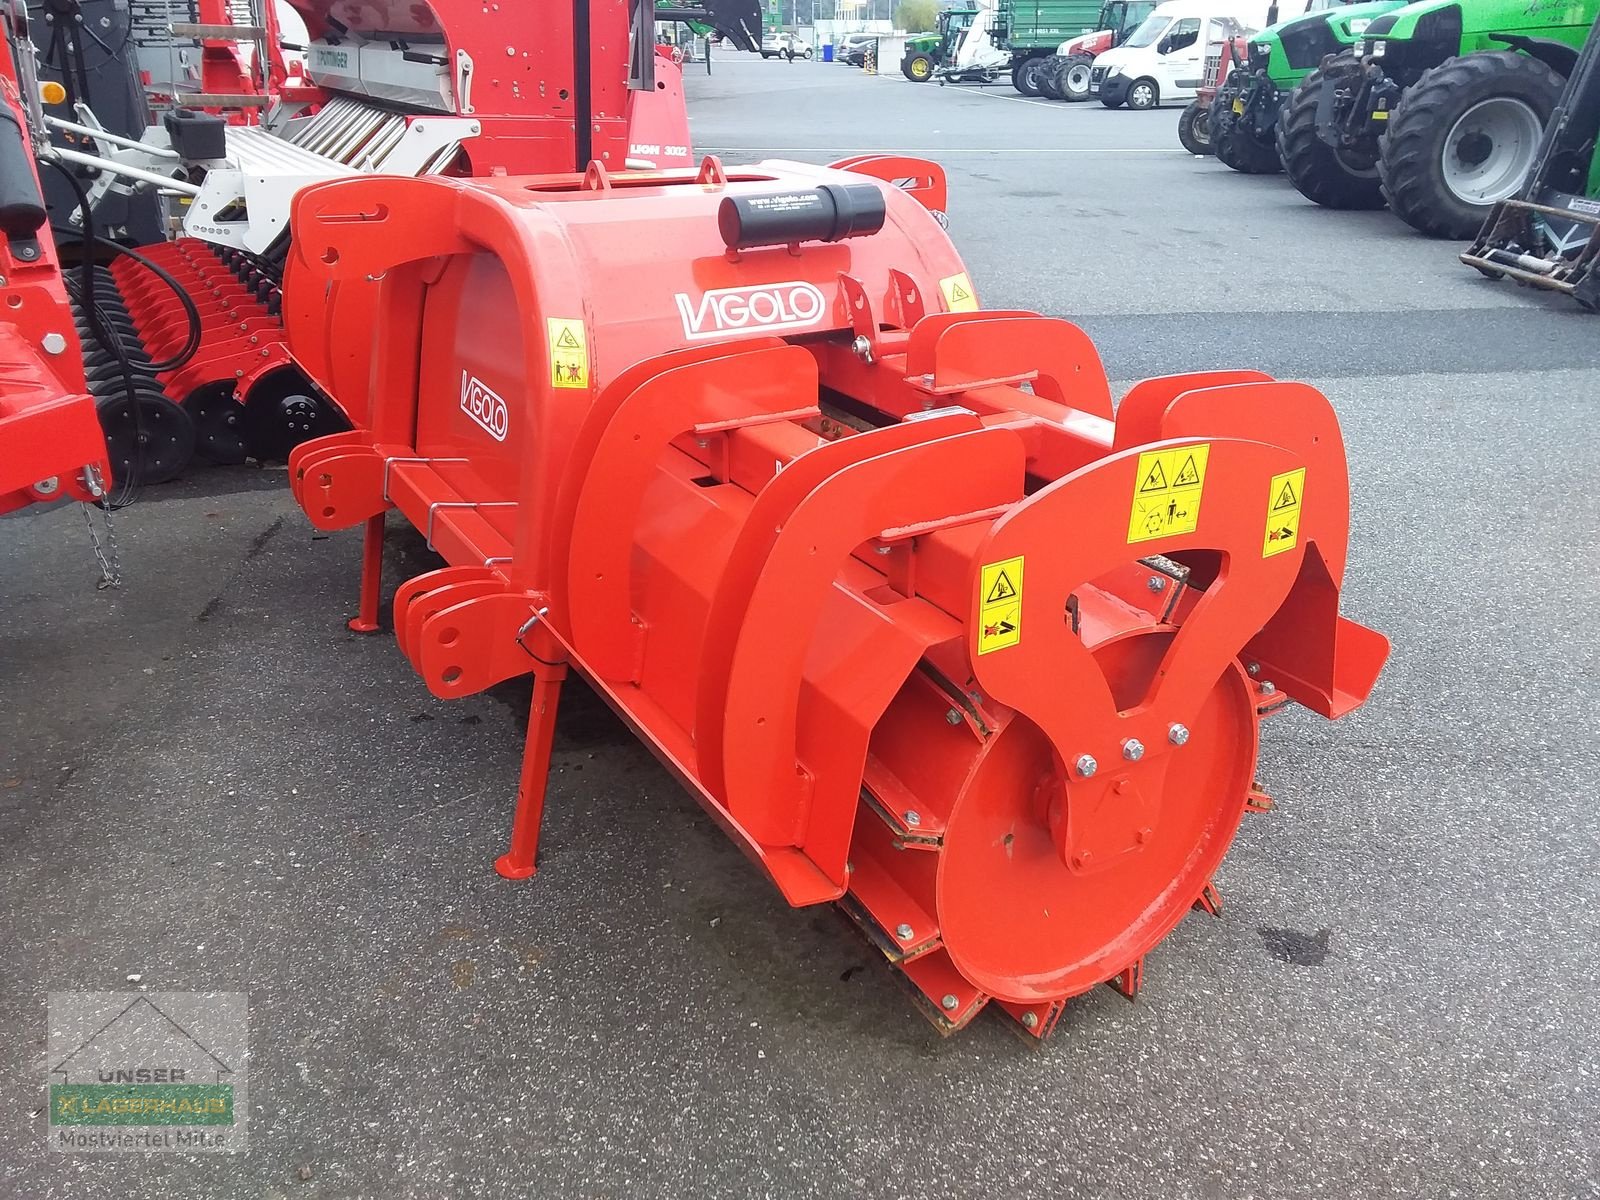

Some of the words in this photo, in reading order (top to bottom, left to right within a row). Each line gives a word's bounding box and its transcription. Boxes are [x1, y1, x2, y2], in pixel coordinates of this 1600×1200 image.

[630, 144, 660, 156] LION
[664, 145, 688, 157] 3002
[674, 285, 822, 336] VIGOLO
[460, 369, 506, 437] VIGOLO
